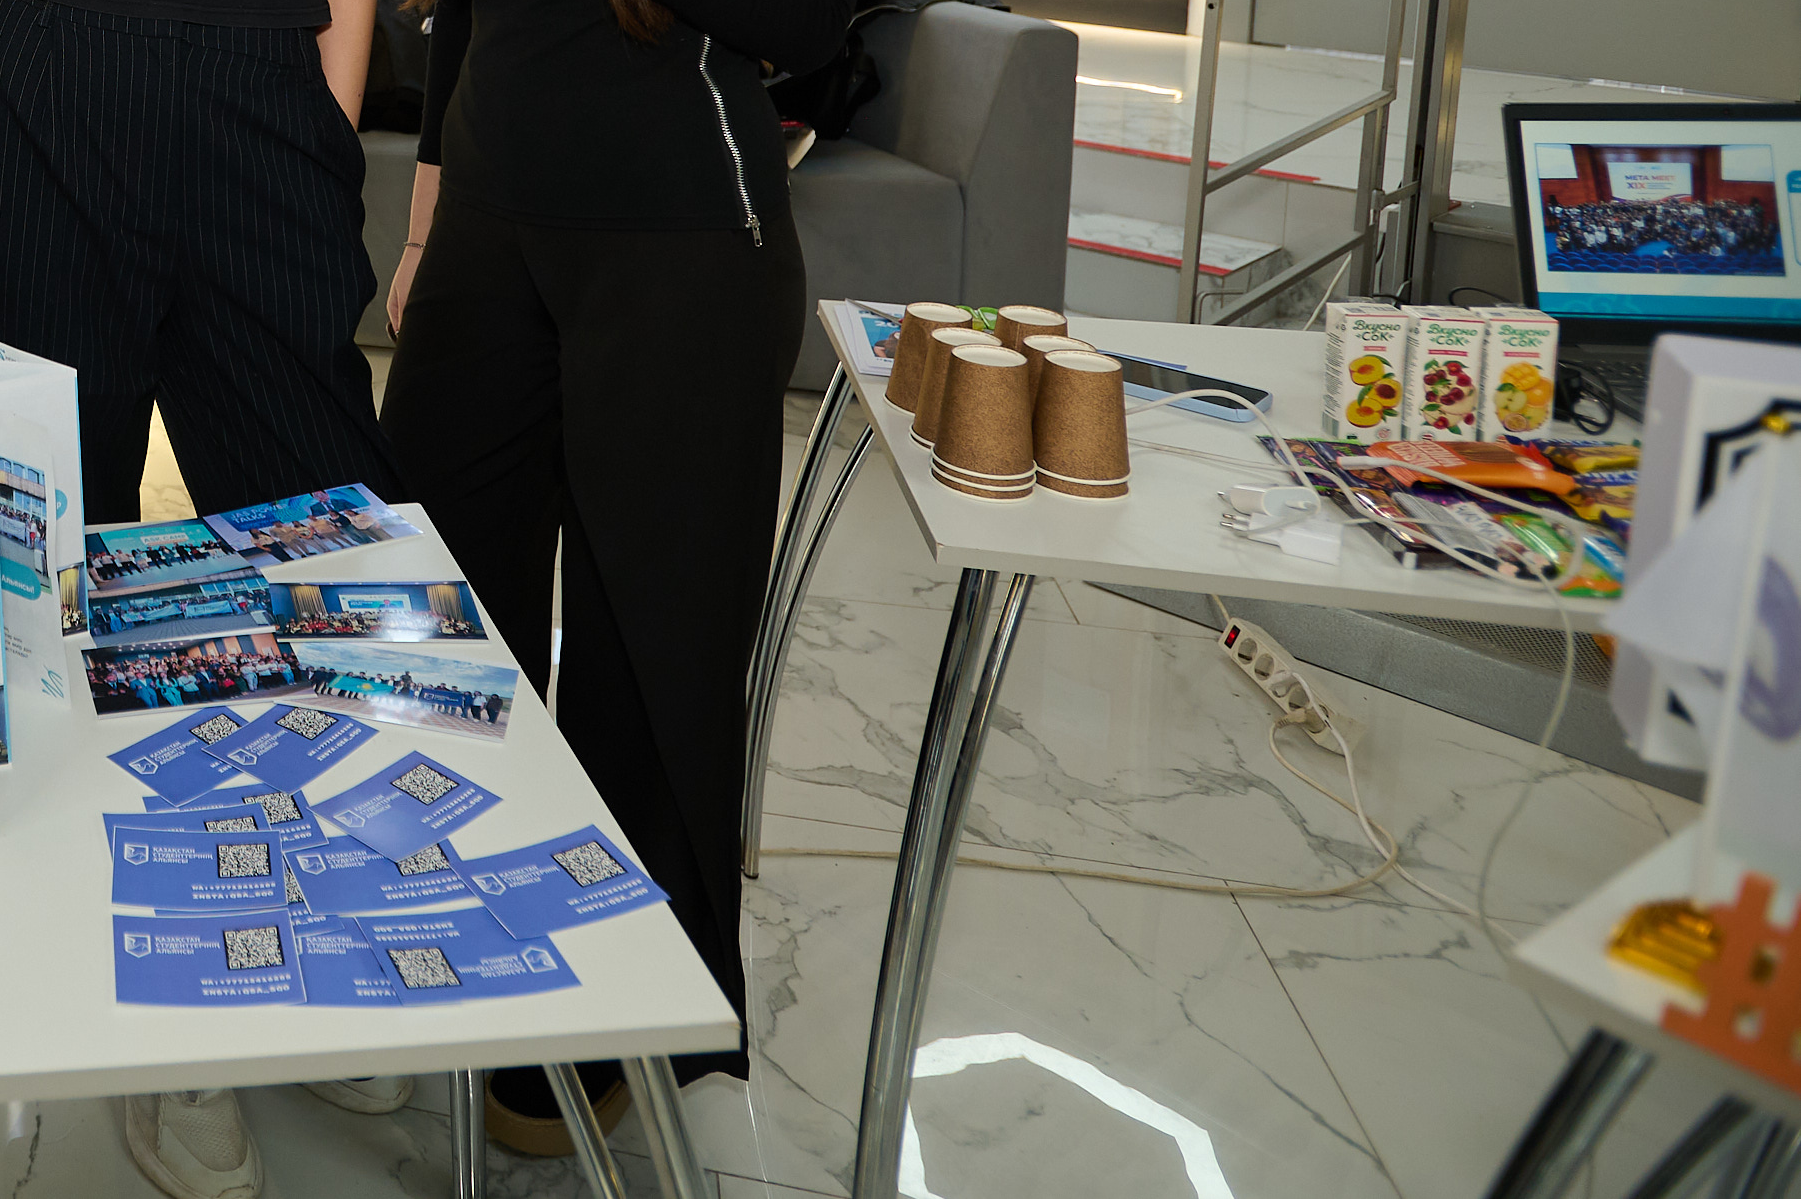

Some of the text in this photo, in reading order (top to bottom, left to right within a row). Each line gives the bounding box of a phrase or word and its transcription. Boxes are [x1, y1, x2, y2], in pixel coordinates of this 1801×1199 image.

[1352, 319, 1402, 332] Вкусно
[1427, 323, 1478, 337] Вкусно
[1498, 324, 1551, 337] Вкусно
